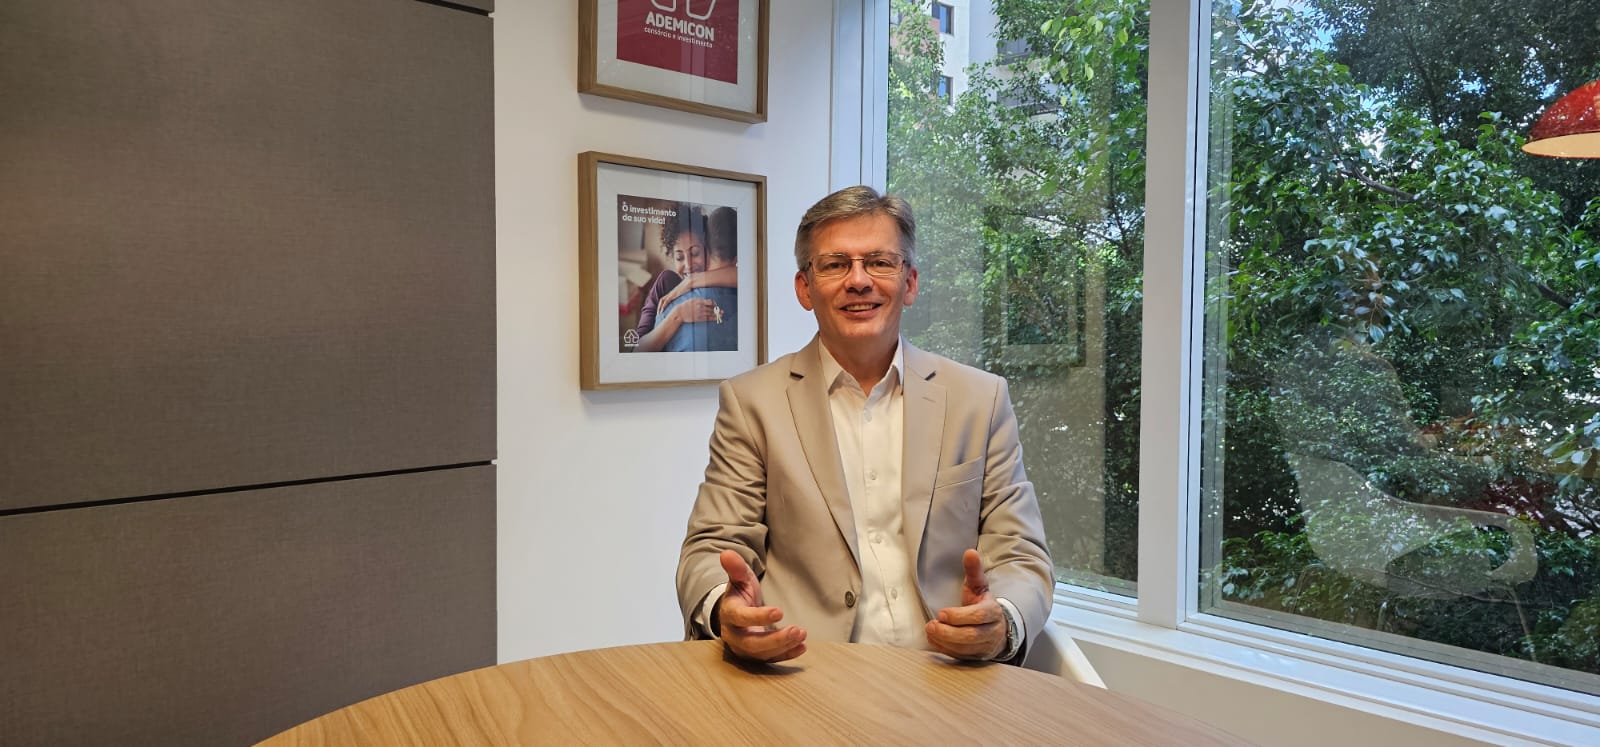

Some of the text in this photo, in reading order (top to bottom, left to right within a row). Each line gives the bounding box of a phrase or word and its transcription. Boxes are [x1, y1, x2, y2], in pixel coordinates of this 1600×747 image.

[645, 11, 715, 41] ADEMICON
[678, 36, 713, 48] investimento
[629, 205, 677, 217] investimento
[647, 216, 666, 225] vida!
